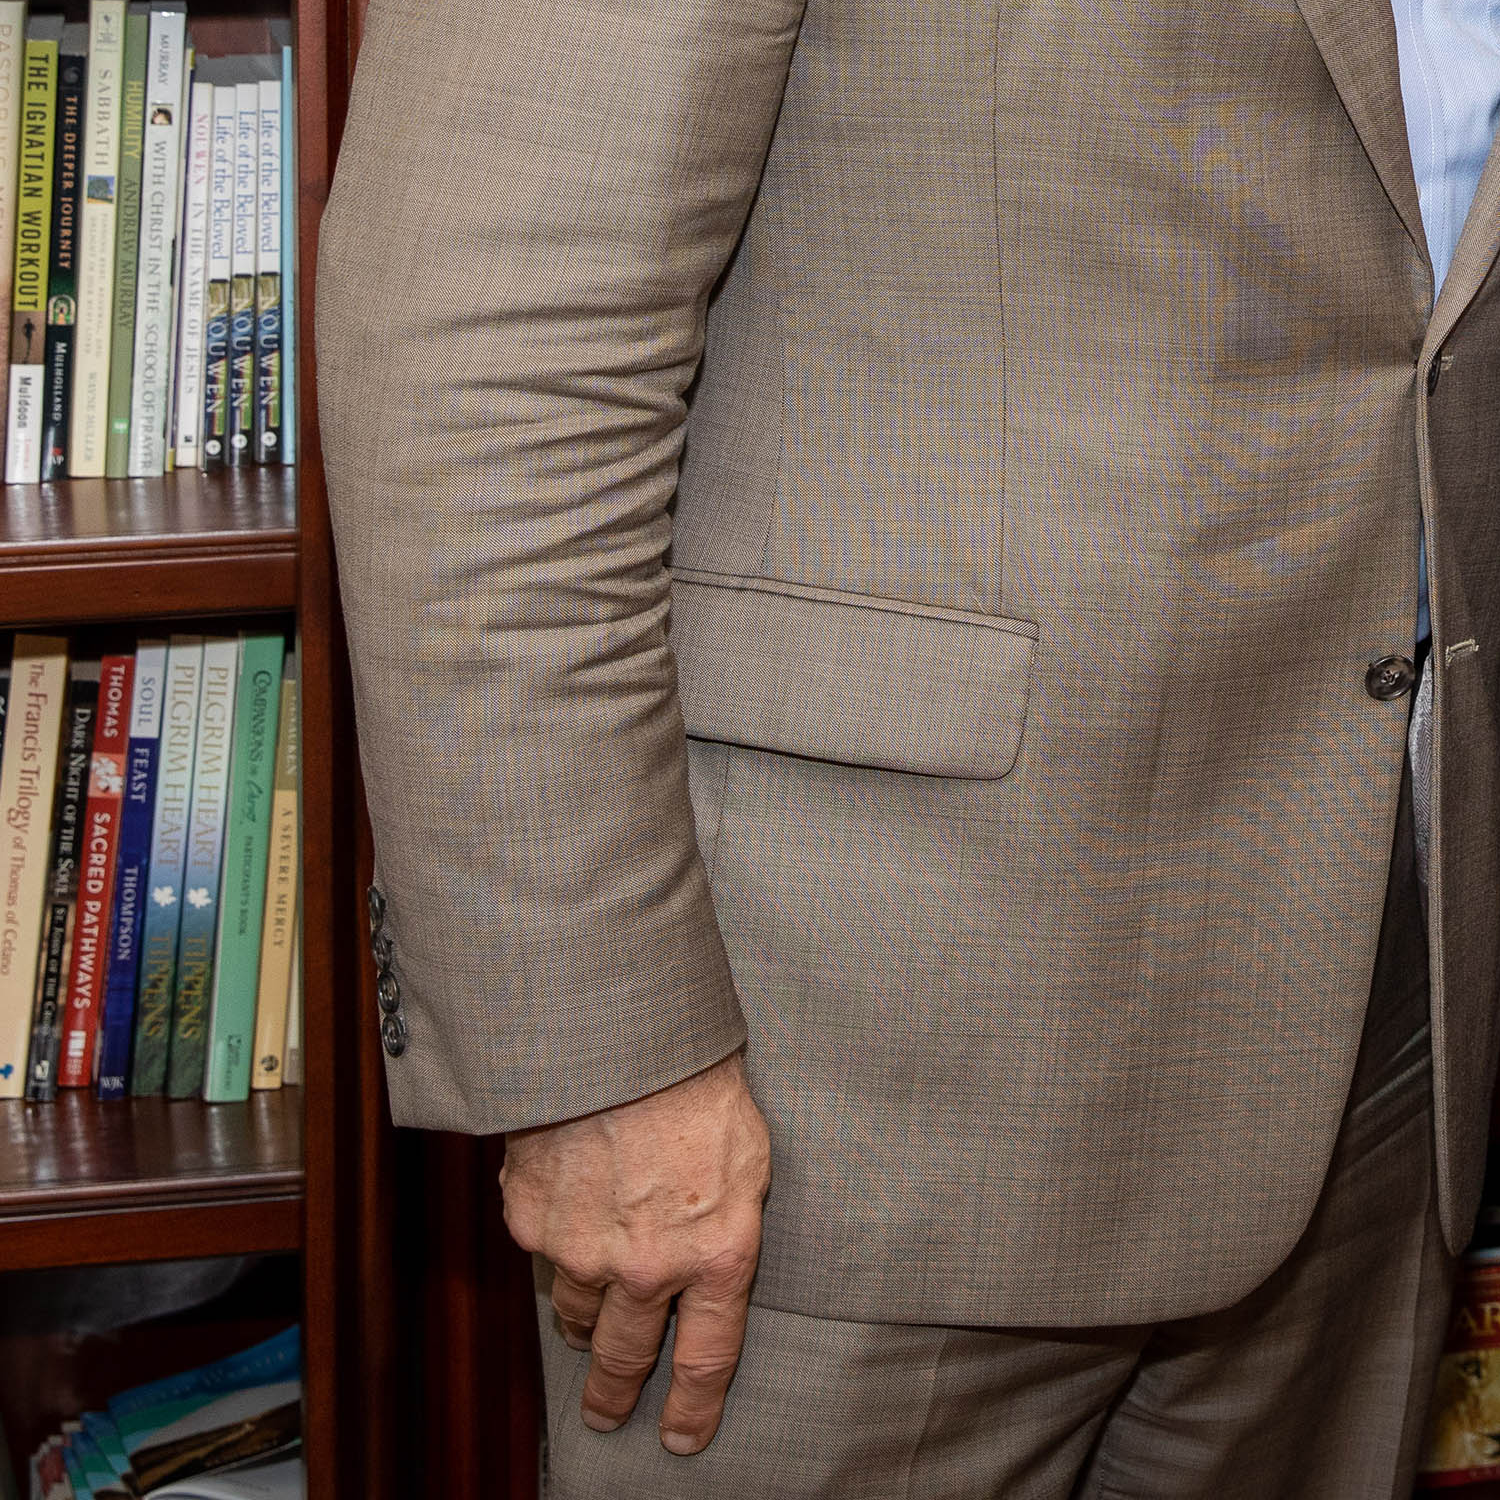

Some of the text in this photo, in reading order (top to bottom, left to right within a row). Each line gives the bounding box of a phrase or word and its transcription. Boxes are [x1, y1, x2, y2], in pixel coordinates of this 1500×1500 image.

[157, 33, 170, 86] MURRAY
[94, 68, 113, 166] SABBATH
[123, 79, 145, 160] HUMILITY
[18, 53, 50, 309] THE IGNATIAN WORKOUT
[59, 95, 78, 269] THE DEEPER JOURNEY
[211, 114, 234, 260] Life of the Beloved
[237, 110, 257, 255] Life of the Beloved
[260, 108, 280, 253] Life of the Beloved
[118, 177, 140, 330] ANDREW MURRAY
[188, 266, 202, 311] NAME
[189, 227, 202, 259] THE
[141, 140, 167, 469] WITH CHRIST IN THE SCHOOL OF PRAYER
[186, 318, 199, 339] OF
[230, 299, 252, 408] NOUWEN
[259, 297, 279, 405] NOUWEN
[17, 376, 33, 429] Muldoon
[184, 346, 199, 395] JESUS
[206, 303, 227, 414] NOUWEN
[72, 708, 92, 749] DARK
[103, 664, 126, 739] THOMAS
[130, 675, 156, 804] SOUL FEAST
[0, 661, 49, 976] The Francis Trilogy of Thomas of Celano
[65, 753, 87, 801] NIGHT
[156, 664, 196, 872] PILGRIM HEART
[190, 665, 229, 873] PILGRIM HEART
[54, 857, 75, 897] SOUL
[60, 826, 75, 855] THE
[272, 808, 293, 948] A SEVERE MERCY
[73, 811, 111, 1010] SACRED PATHWAYS
[117, 865, 139, 961] THOMPSON
[142, 931, 173, 1037] TIPPENS
[179, 932, 208, 1039] TIPPENS
